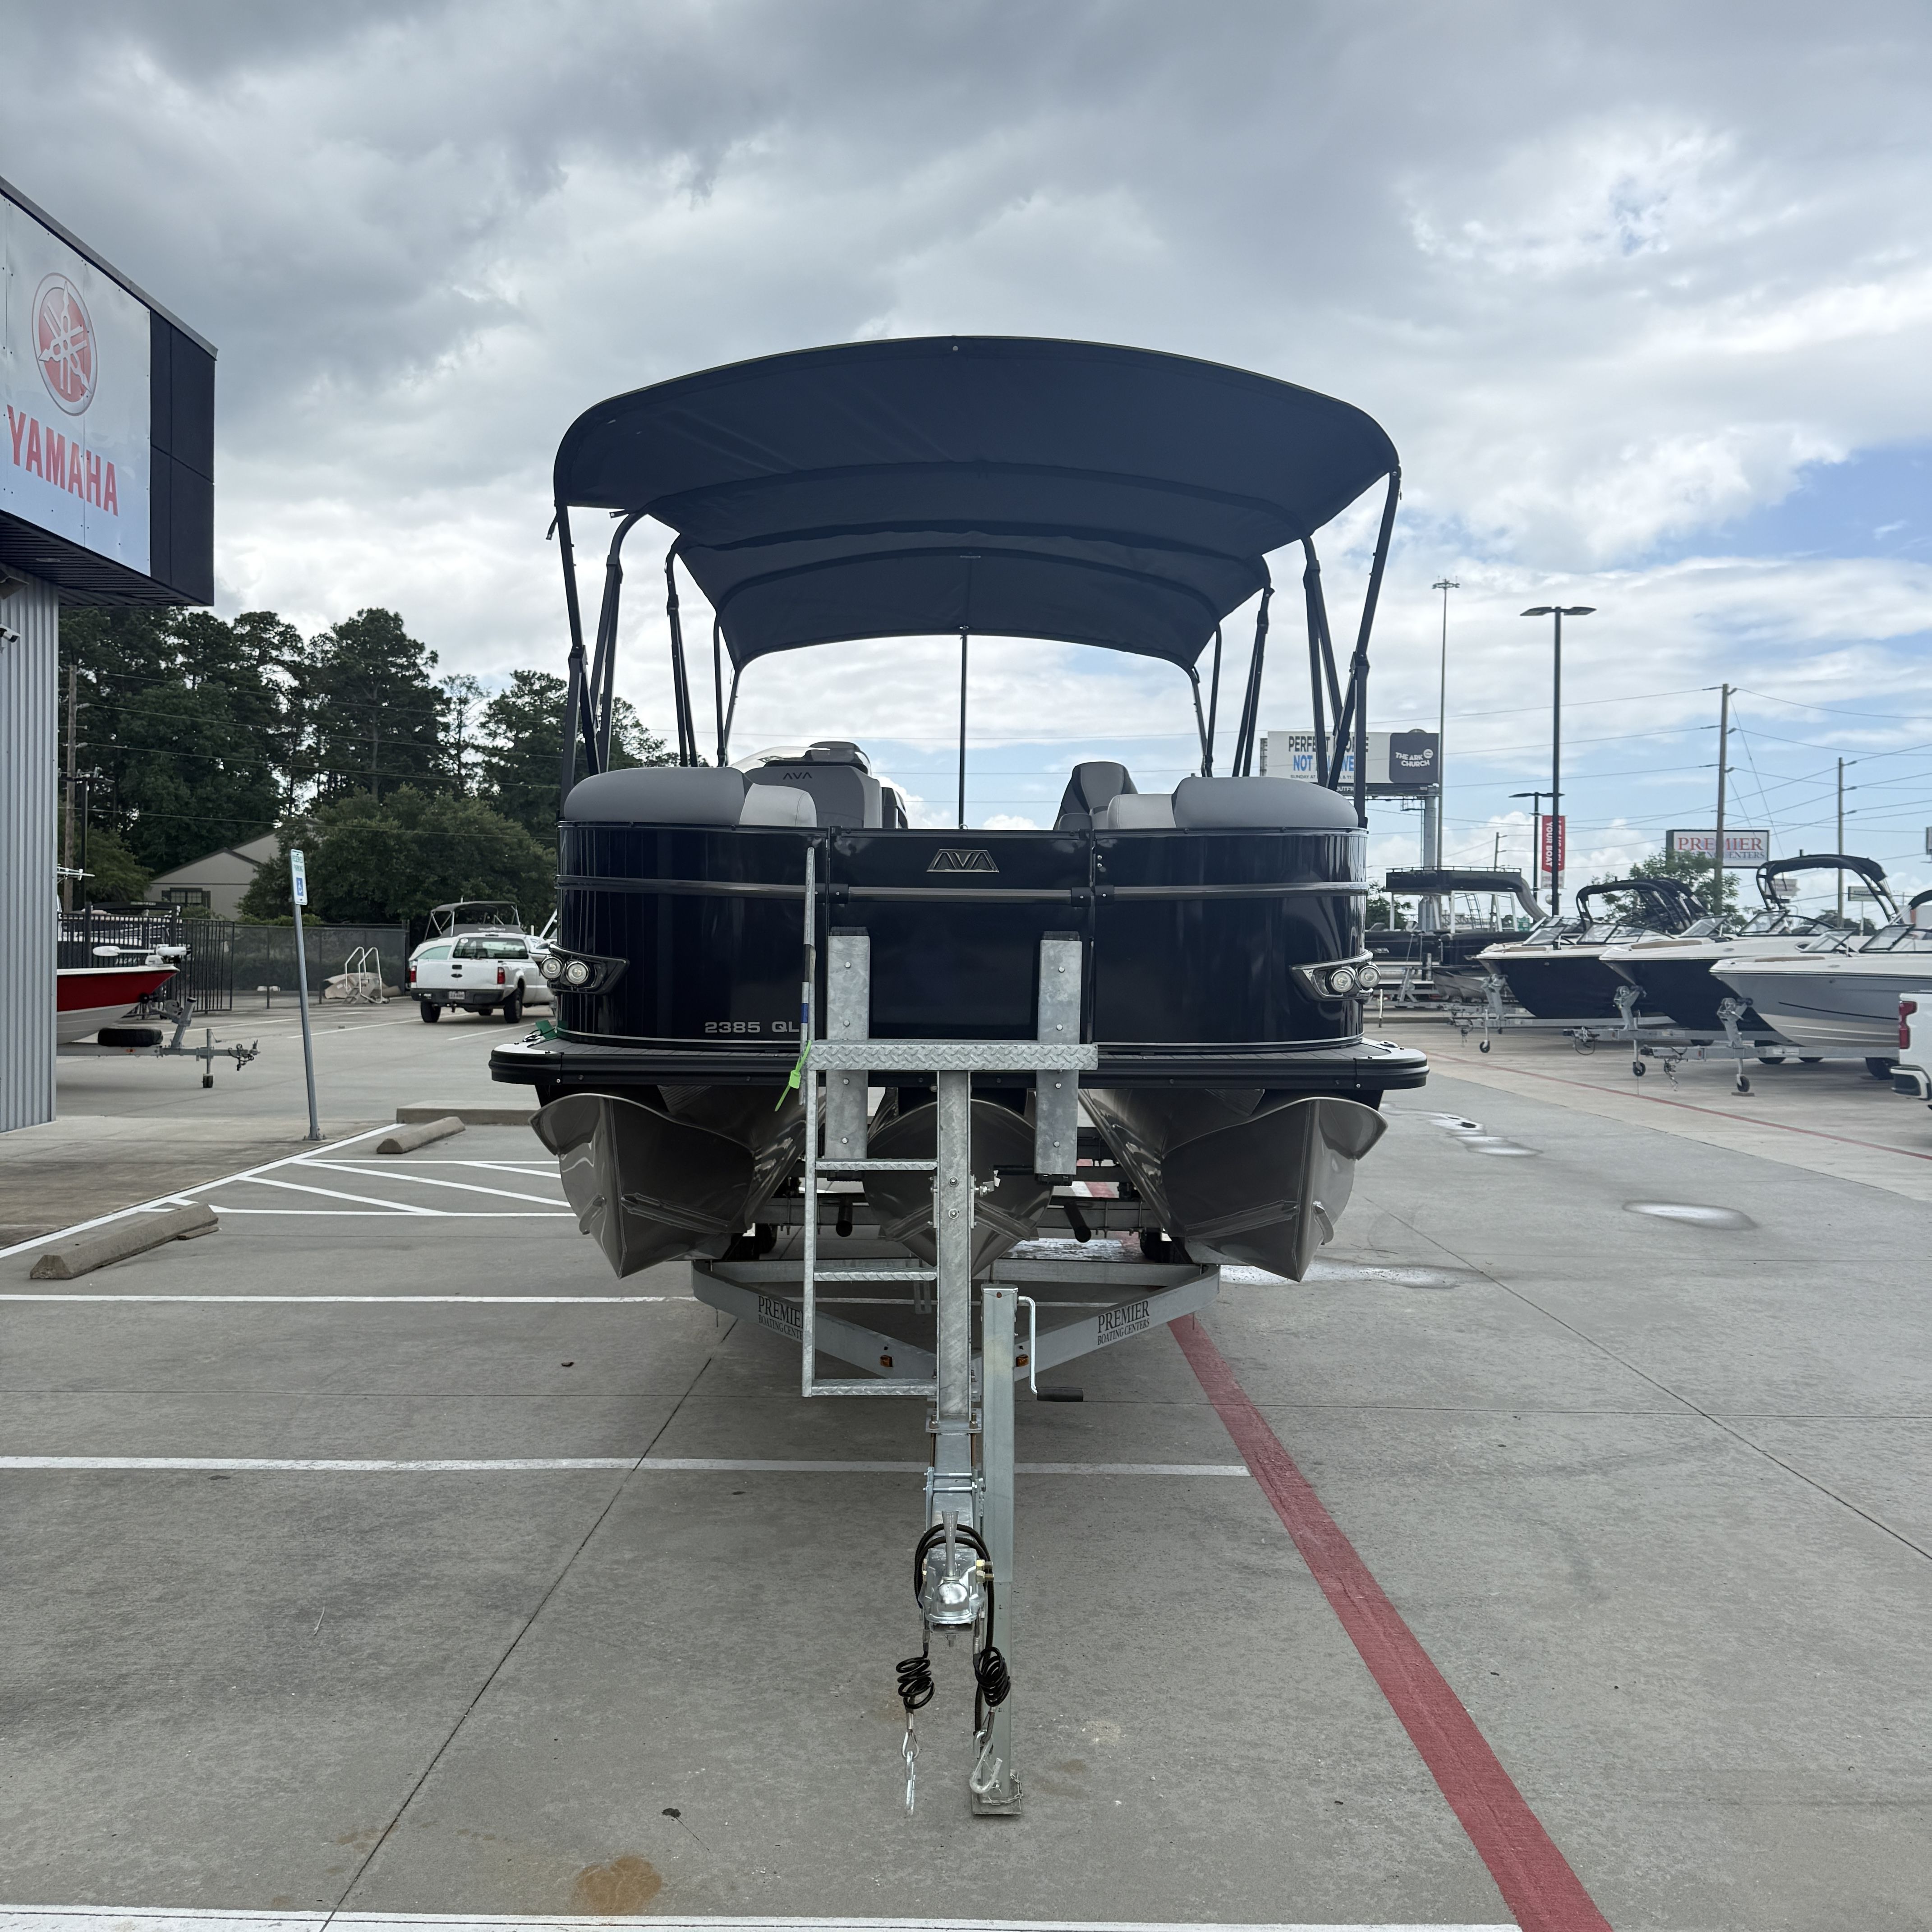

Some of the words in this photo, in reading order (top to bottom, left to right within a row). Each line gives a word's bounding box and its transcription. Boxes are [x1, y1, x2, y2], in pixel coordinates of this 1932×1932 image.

[7, 404, 118, 516] YAMAHA
[1288, 736, 1330, 752] PERFET
[1293, 755, 1313, 771] NOT
[1395, 752, 1408, 760] THE
[783, 772, 813, 780] AVA
[932, 851, 995, 870] AVA
[705, 1022, 761, 1033] 2385
[758, 1314, 784, 1333] BOATING
[1098, 1300, 1150, 1334] PREMIER
[1098, 1327, 1124, 1346] BOATING
[1124, 1318, 1150, 1335] CENTERS
